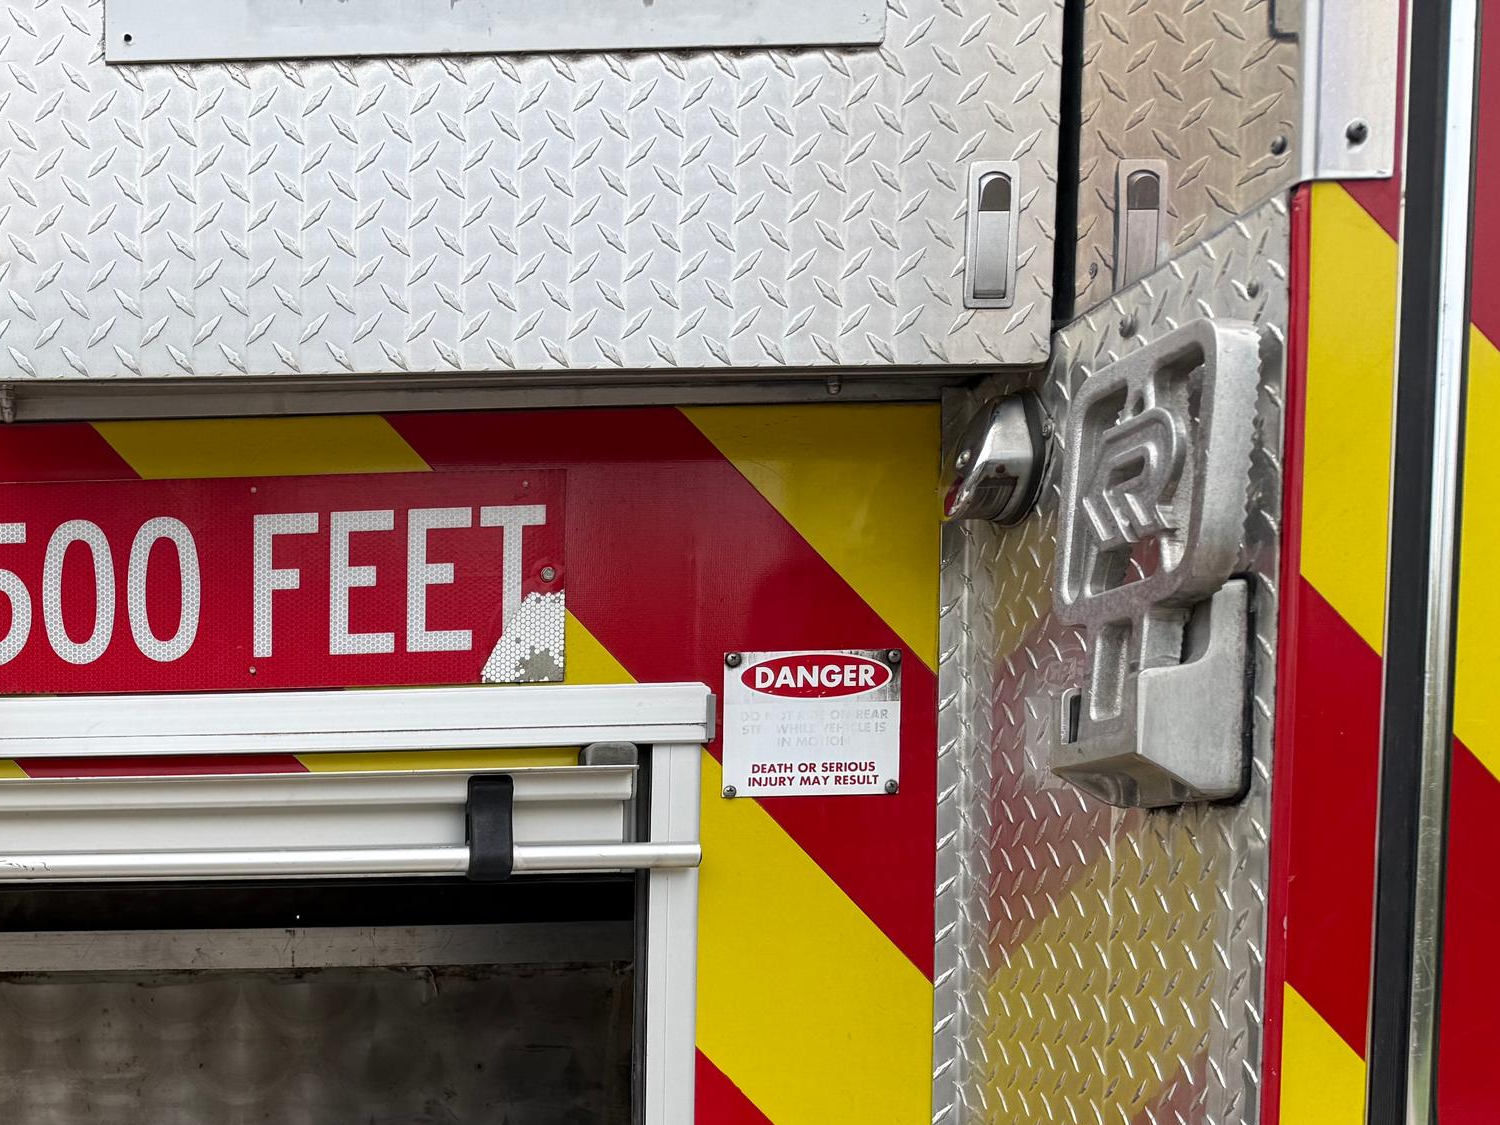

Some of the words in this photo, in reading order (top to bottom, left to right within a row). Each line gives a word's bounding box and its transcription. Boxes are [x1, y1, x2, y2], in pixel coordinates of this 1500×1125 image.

[252, 504, 547, 658] FEET
[755, 664, 876, 689] DANGER
[855, 709, 888, 720] REAR
[776, 723, 815, 734] WHILE
[824, 722, 871, 733] VEHCLE
[875, 722, 886, 732] IS
[777, 737, 792, 747] IN
[795, 736, 851, 747] MOIO
[751, 763, 793, 774] DEATH
[797, 763, 816, 773] OR
[821, 761, 876, 772] SERIOUS
[748, 776, 795, 787] INJURY
[799, 776, 830, 786] MAY
[834, 775, 879, 785] RESULT
